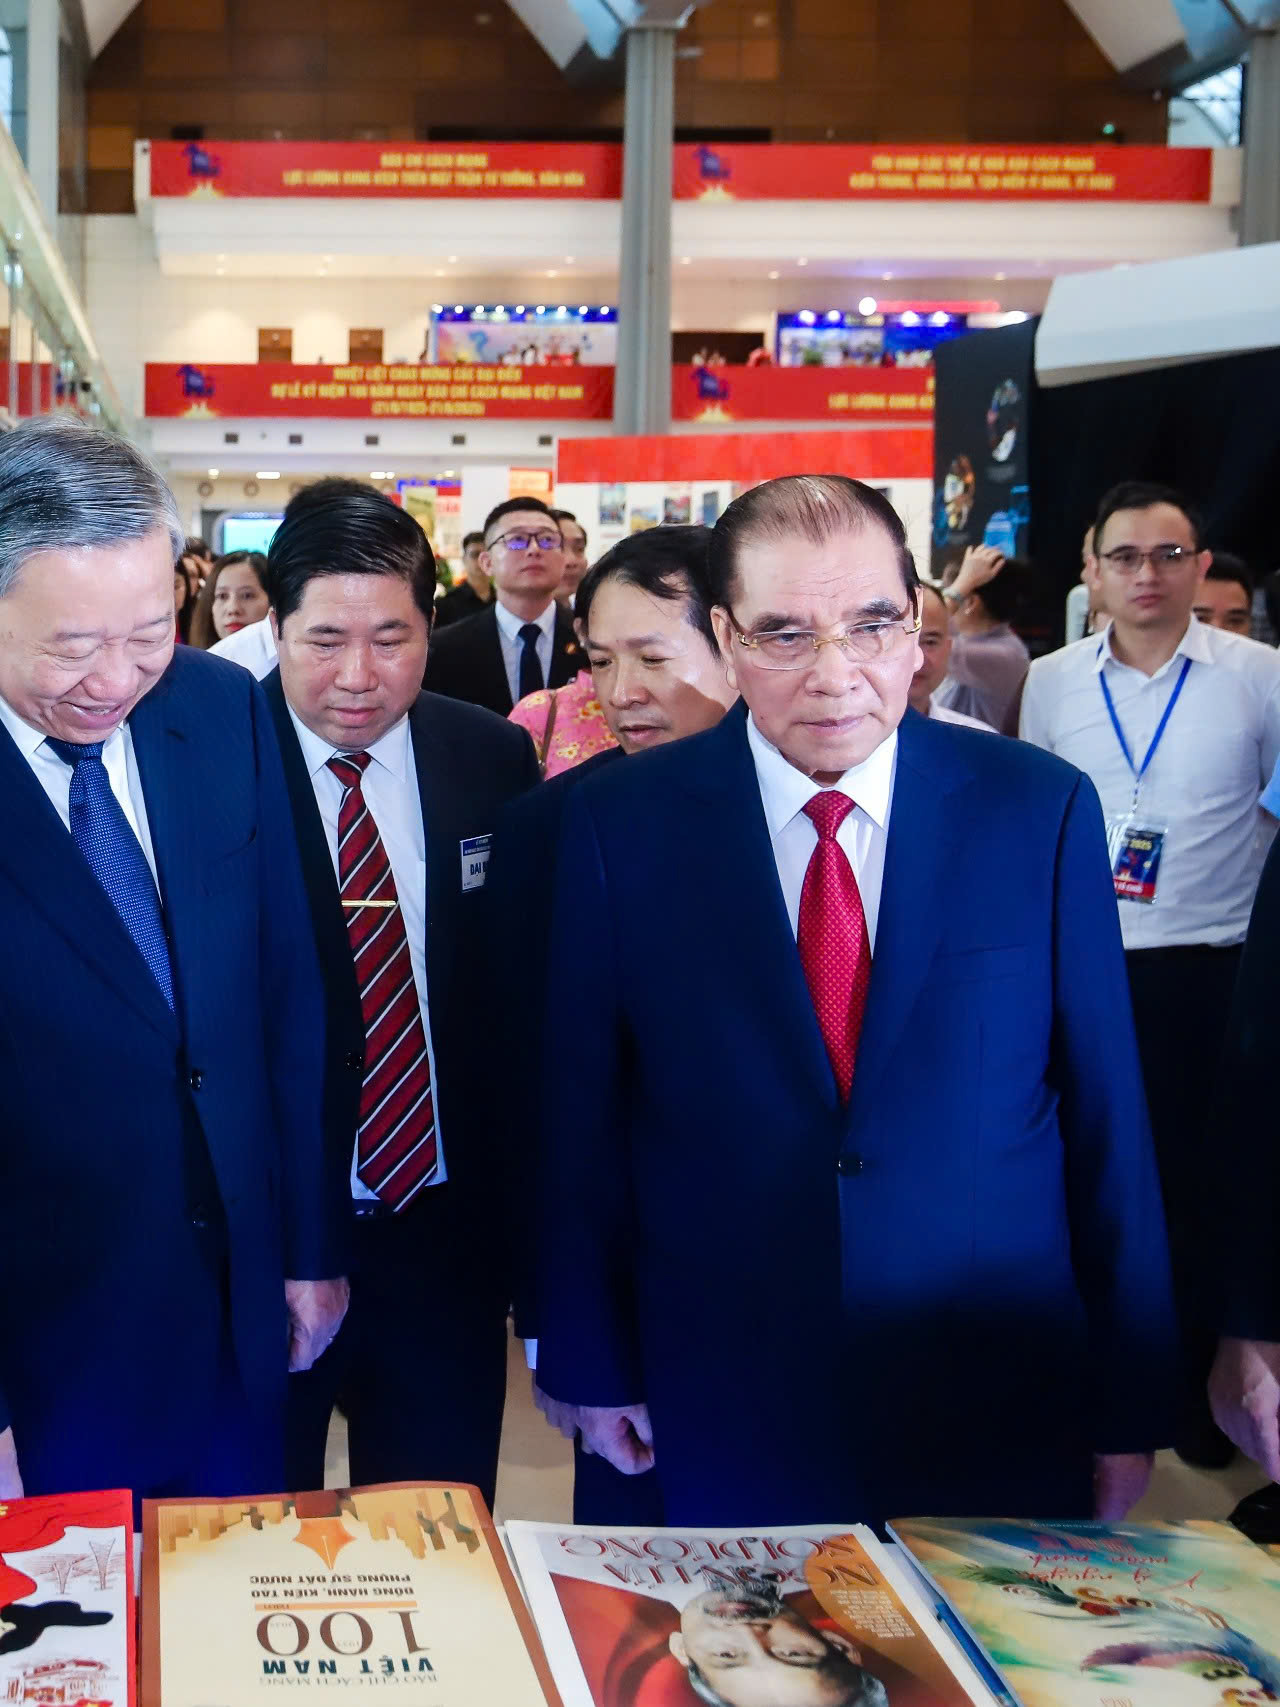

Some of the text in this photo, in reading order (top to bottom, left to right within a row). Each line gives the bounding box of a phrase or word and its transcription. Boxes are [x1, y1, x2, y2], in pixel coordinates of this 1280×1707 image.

[256, 1611, 431, 1657] 100
[262, 1656, 434, 1677] VIỆT NAM
